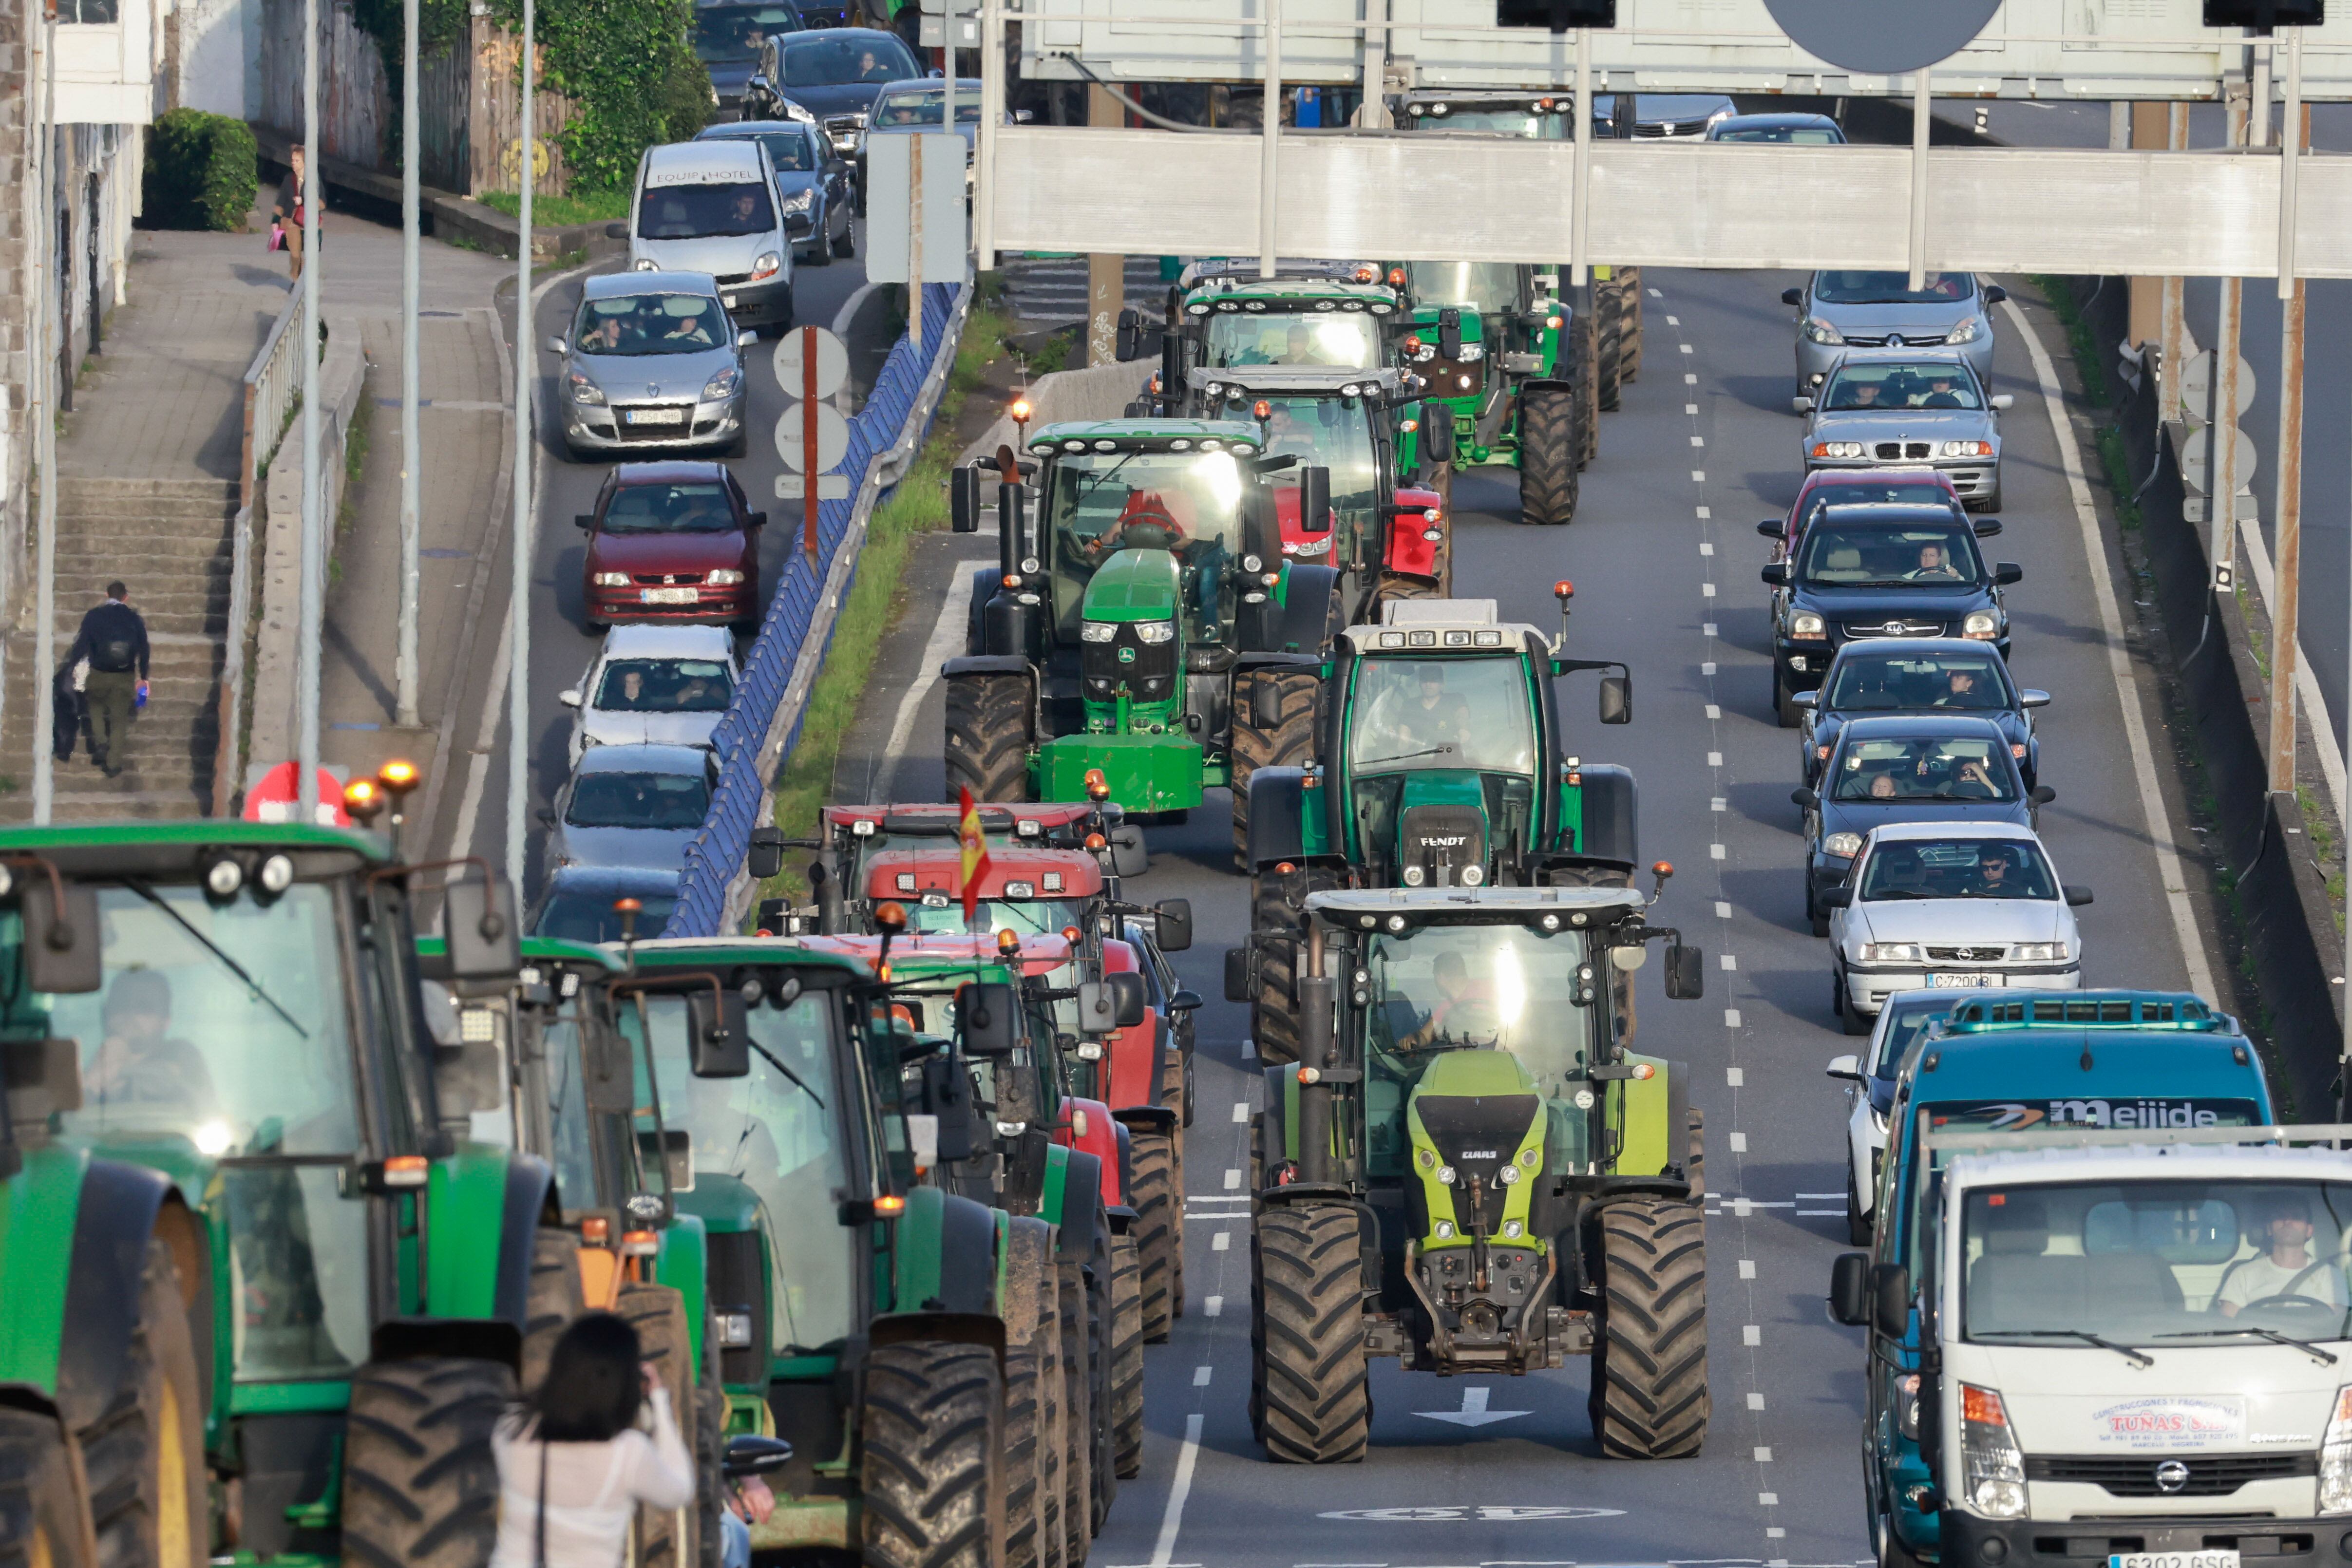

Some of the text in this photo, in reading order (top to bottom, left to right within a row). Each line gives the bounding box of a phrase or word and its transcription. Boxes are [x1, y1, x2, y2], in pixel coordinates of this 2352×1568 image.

[709, 170, 754, 179] HOTEL
[1420, 837, 1466, 846] FENDT
[1462, 1150, 1497, 1158] CLAAS
[2092, 1398, 2167, 1420] CONSTRUCCIONES
[2111, 1412, 2182, 1430] TUÑAS
